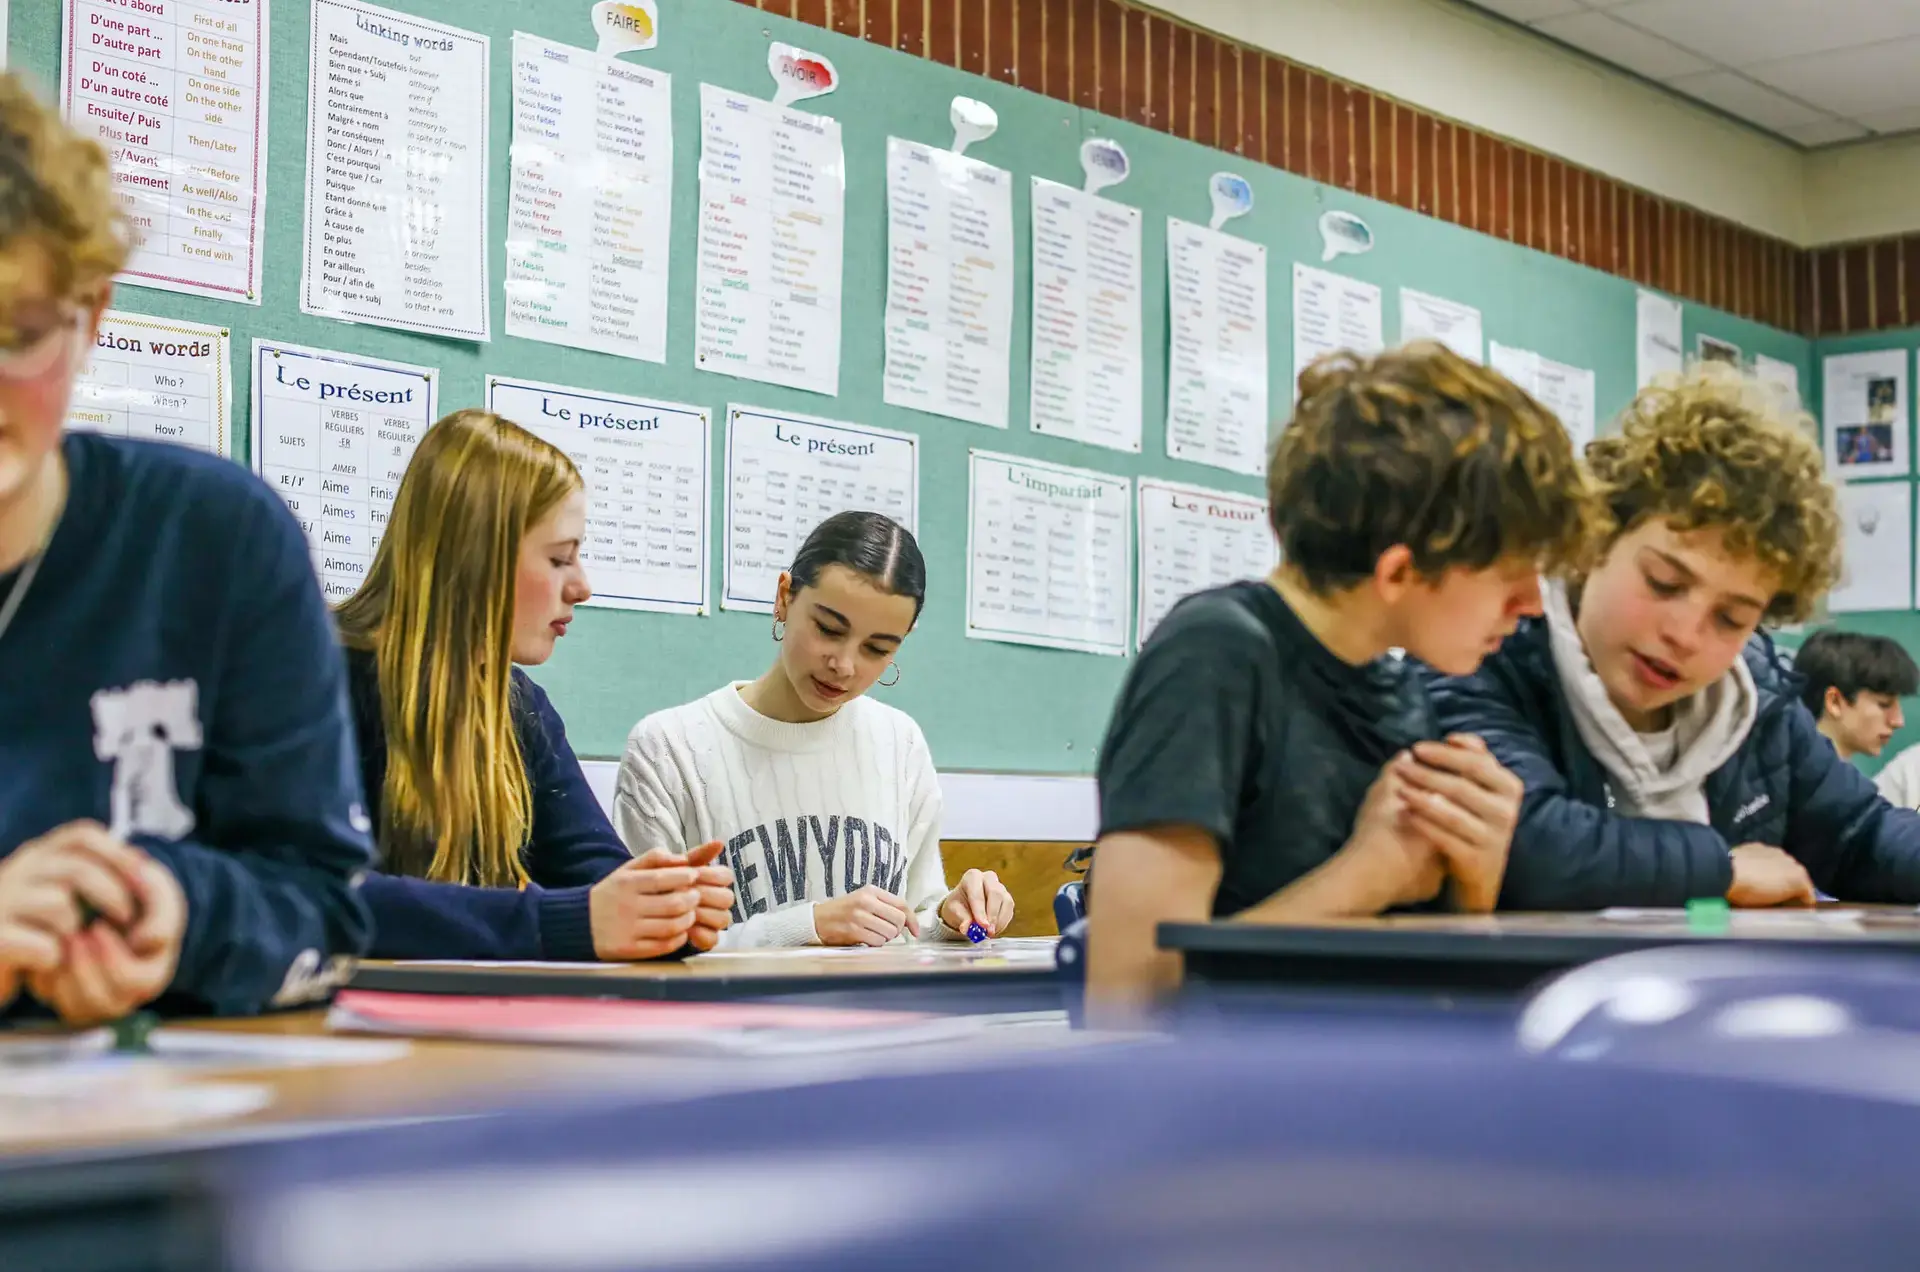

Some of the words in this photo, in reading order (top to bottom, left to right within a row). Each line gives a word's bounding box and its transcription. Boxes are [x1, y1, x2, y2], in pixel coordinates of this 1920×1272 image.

[91, 14, 124, 31] D'une
[128, 23, 151, 37] part
[194, 14, 214, 27] First
[216, 20, 225, 31] of
[227, 23, 238, 32] all
[606, 12, 641, 33] FAIRE
[330, 33, 348, 44] Mais
[355, 13, 409, 46] Linking
[414, 35, 454, 52] words
[92, 33, 135, 53] D'autre
[138, 45, 161, 59] part
[187, 32, 200, 41] On
[202, 36, 219, 46] one
[222, 39, 243, 53] hand
[187, 47, 200, 57] On
[203, 50, 217, 61] the
[219, 55, 243, 67] other
[329, 47, 407, 72] Cependant/Toutefois
[93, 61, 118, 77] D'un
[122, 70, 146, 83] coté
[203, 65, 226, 79] hand
[329, 60, 345, 70] Bien
[347, 65, 362, 74] que
[370, 69, 386, 81] Subj
[781, 63, 817, 84] AVOIR
[329, 72, 353, 86] Même
[81, 78, 108, 94] D'un
[111, 87, 141, 101] autre
[144, 94, 168, 107] coté
[188, 78, 202, 88] On
[204, 82, 221, 94] one
[222, 85, 240, 97] side
[328, 86, 347, 97] Alors
[349, 92, 364, 101] que
[186, 93, 199, 104] On
[202, 96, 217, 108] the
[217, 99, 242, 112] other
[328, 100, 382, 119] Contrairement
[384, 111, 389, 120] à
[88, 103, 135, 125] Ensuite/
[138, 114, 161, 129] Puis
[204, 111, 223, 124] side
[328, 113, 354, 125] Malgré
[362, 121, 379, 130] nom
[99, 125, 122, 140] Plus
[125, 132, 148, 145] tard
[328, 126, 340, 135] Par
[342, 130, 385, 145] conséquent
[188, 135, 237, 153] Then/Later
[327, 139, 346, 150] Donc
[354, 145, 372, 157] Alors
[326, 152, 345, 164] C'est
[347, 159, 381, 171] pourquoi
[326, 166, 347, 178] Parce
[349, 170, 363, 180] que
[370, 175, 382, 185] Car
[183, 183, 193, 193] As
[196, 186, 238, 202] well/Also
[326, 179, 356, 192] Puisque
[325, 192, 345, 203] Etant
[347, 197, 371, 210] donné
[186, 205, 195, 215] In
[197, 207, 212, 219] the
[325, 206, 347, 217] Grâce
[348, 211, 353, 219] à
[194, 226, 223, 241] Finally
[332, 222, 353, 232] cause
[355, 226, 364, 234] de
[324, 232, 334, 241] De
[337, 236, 352, 244] plus
[182, 244, 193, 254] To
[196, 246, 212, 258] end
[214, 251, 233, 261] with
[324, 246, 333, 255] En
[335, 250, 356, 259] outre
[324, 259, 336, 268] Par
[338, 261, 365, 274] ailleurs
[324, 273, 341, 283] Pour
[349, 278, 364, 288] afin
[365, 280, 375, 289] de
[343, 291, 358, 300] que
[365, 294, 382, 306] subj
[149, 342, 210, 357] words
[155, 375, 177, 387] Who
[179, 378, 184, 387] ?
[275, 360, 310, 390] Le
[319, 383, 414, 404] présent
[151, 395, 179, 407] When
[182, 398, 187, 408] ?
[331, 409, 359, 421] VERBES
[541, 396, 571, 421] Le
[579, 414, 660, 431] présent
[155, 424, 177, 435] How
[179, 426, 184, 435] ?
[325, 422, 365, 436] REGULIERS
[383, 418, 410, 429] VERBES
[279, 435, 305, 447] SUJETS
[378, 430, 416, 443] REGULIERS
[776, 423, 801, 446] Le
[807, 437, 876, 456] présent
[332, 464, 357, 474] AIMER
[281, 475, 290, 484] JE
[298, 477, 304, 486] J'
[322, 480, 349, 494] Aime
[1007, 466, 1102, 499] L'imparfait
[370, 486, 393, 500] Finis
[288, 500, 299, 510] TU
[323, 504, 355, 519] Aimes
[1172, 495, 1199, 512] Le
[1207, 504, 1257, 521] futur
[324, 531, 351, 545] Aime
[324, 558, 363, 573] Aimons
